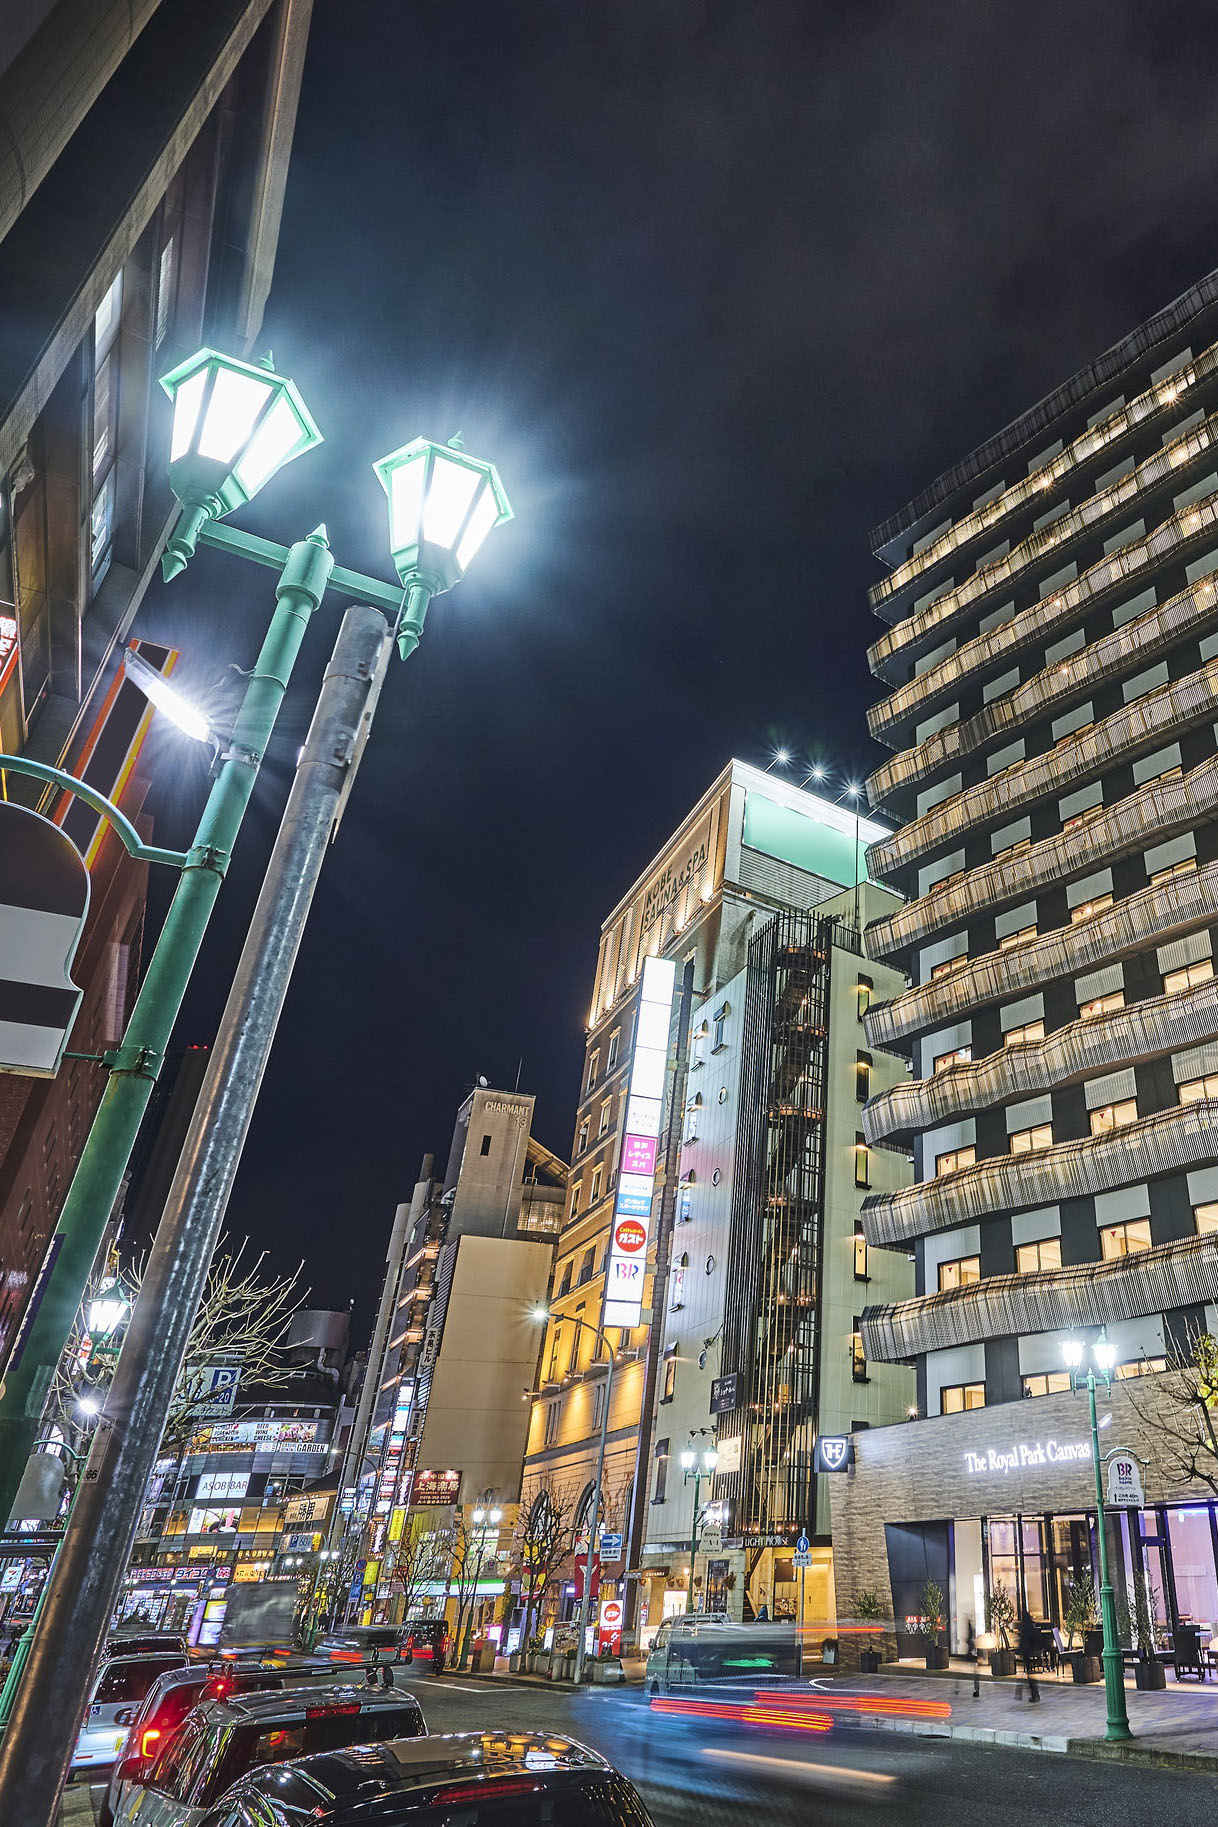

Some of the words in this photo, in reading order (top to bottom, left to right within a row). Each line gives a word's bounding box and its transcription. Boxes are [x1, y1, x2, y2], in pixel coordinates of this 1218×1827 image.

[644, 877, 678, 929] SAUNA
[685, 843, 705, 881] SPA
[646, 863, 673, 908] KOBE
[485, 1100, 530, 1117] CHARMANT
[618, 1232, 644, 1244] ガスト
[296, 1443, 325, 1452] GARDEN
[965, 1452, 987, 1473] The
[987, 1446, 1019, 1474] Royal
[1019, 1443, 1046, 1465] Park
[1046, 1440, 1091, 1462] Canvas
[1117, 1463, 1132, 1476] BR
[230, 1480, 248, 1489] BAR
[745, 1537, 765, 1547] LIGHT
